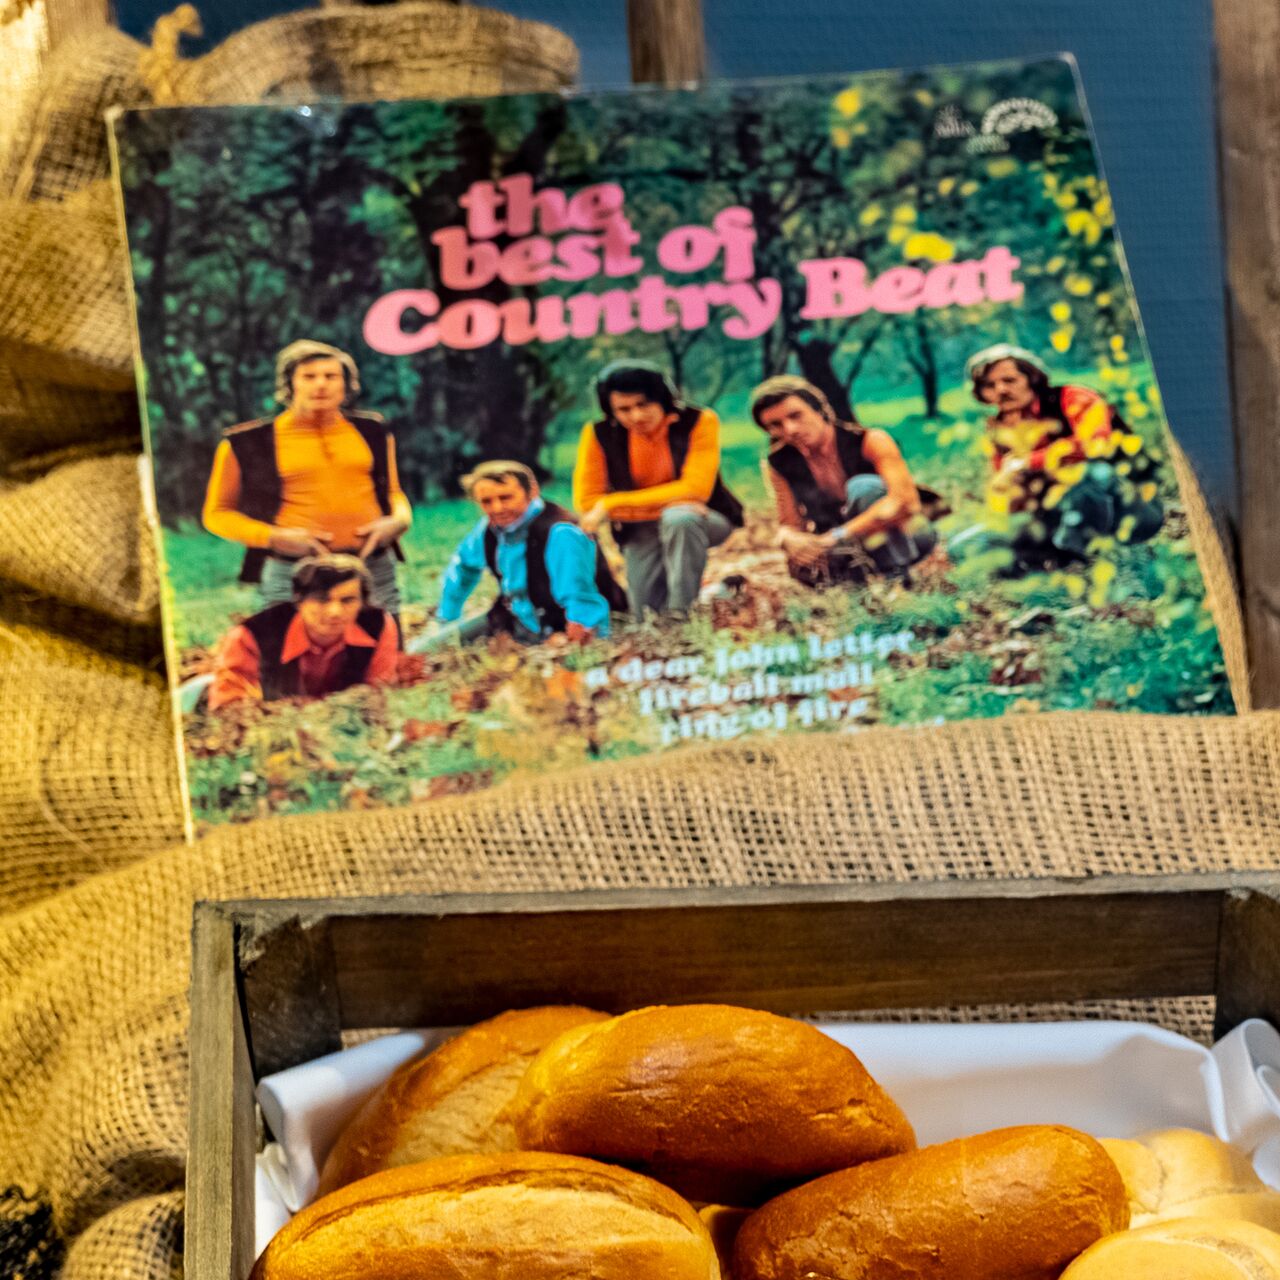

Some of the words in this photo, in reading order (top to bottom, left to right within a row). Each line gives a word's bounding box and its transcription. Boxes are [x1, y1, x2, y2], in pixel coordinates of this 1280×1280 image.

[460, 173, 625, 240] the
[431, 221, 644, 290] best
[656, 206, 757, 281] of
[362, 275, 782, 356] Country
[797, 246, 1024, 319] Beat
[618, 656, 704, 684] dear
